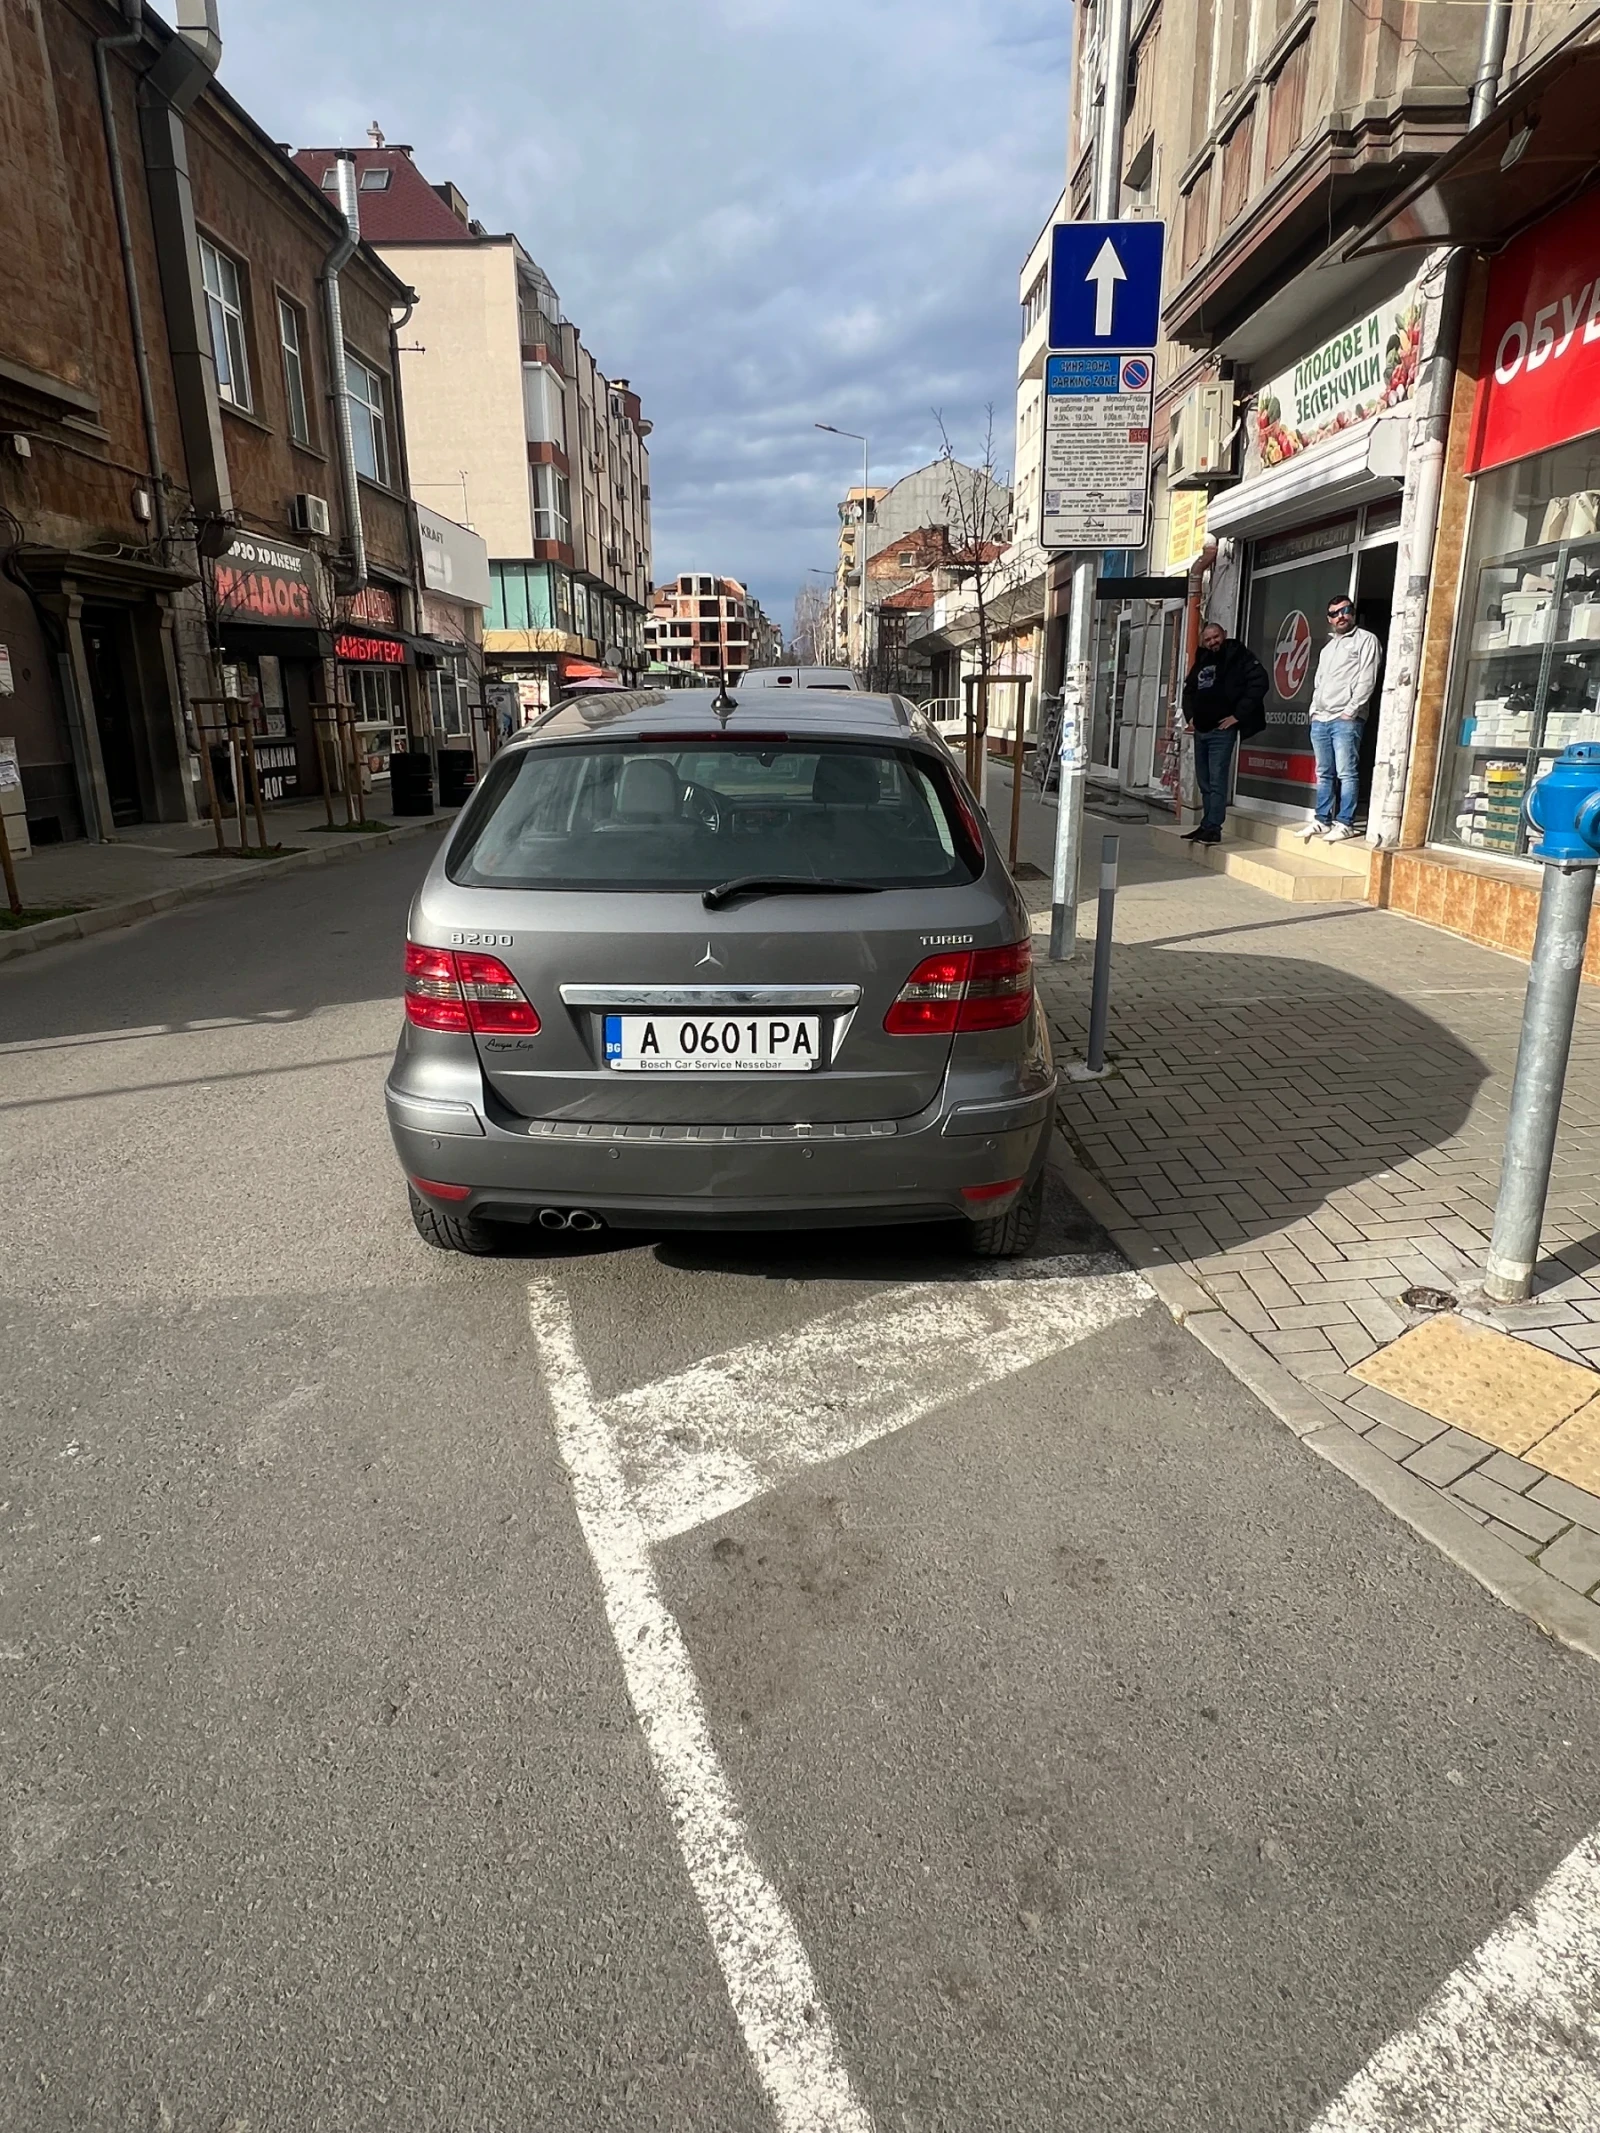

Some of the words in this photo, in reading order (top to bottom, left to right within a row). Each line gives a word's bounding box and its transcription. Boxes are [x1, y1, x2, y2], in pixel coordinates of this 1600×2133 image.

[1294, 325, 1363, 397] ПЛОДОВЕ
[1368, 314, 1380, 349] И
[1061, 360, 1084, 372] СИНЯ
[1086, 360, 1111, 372] ЗОНА
[1052, 376, 1091, 388] PARKING
[1092, 375, 1118, 387] ZONE
[1296, 352, 1381, 425] ЗЕЛЕНЧУЦИ
[1106, 395, 1147, 405] Monday-Friday
[1103, 404, 1113, 412] and
[1114, 404, 1135, 413] working
[1135, 404, 1148, 413] days
[420, 522, 444, 545] KRAFT
[214, 564, 311, 619] МЛАДОСТ
[1265, 711, 1287, 725] DESSO
[1287, 711, 1308, 725] CREDI
[451, 932, 514, 947] B200
[919, 934, 974, 946] TURBO
[640, 1022, 660, 1054] A
[606, 1043, 621, 1053] BG
[640, 1060, 672, 1069] Bosch
[674, 1060, 693, 1069] Car
[695, 1060, 732, 1069] Service
[735, 1060, 782, 1069] Nessebar
